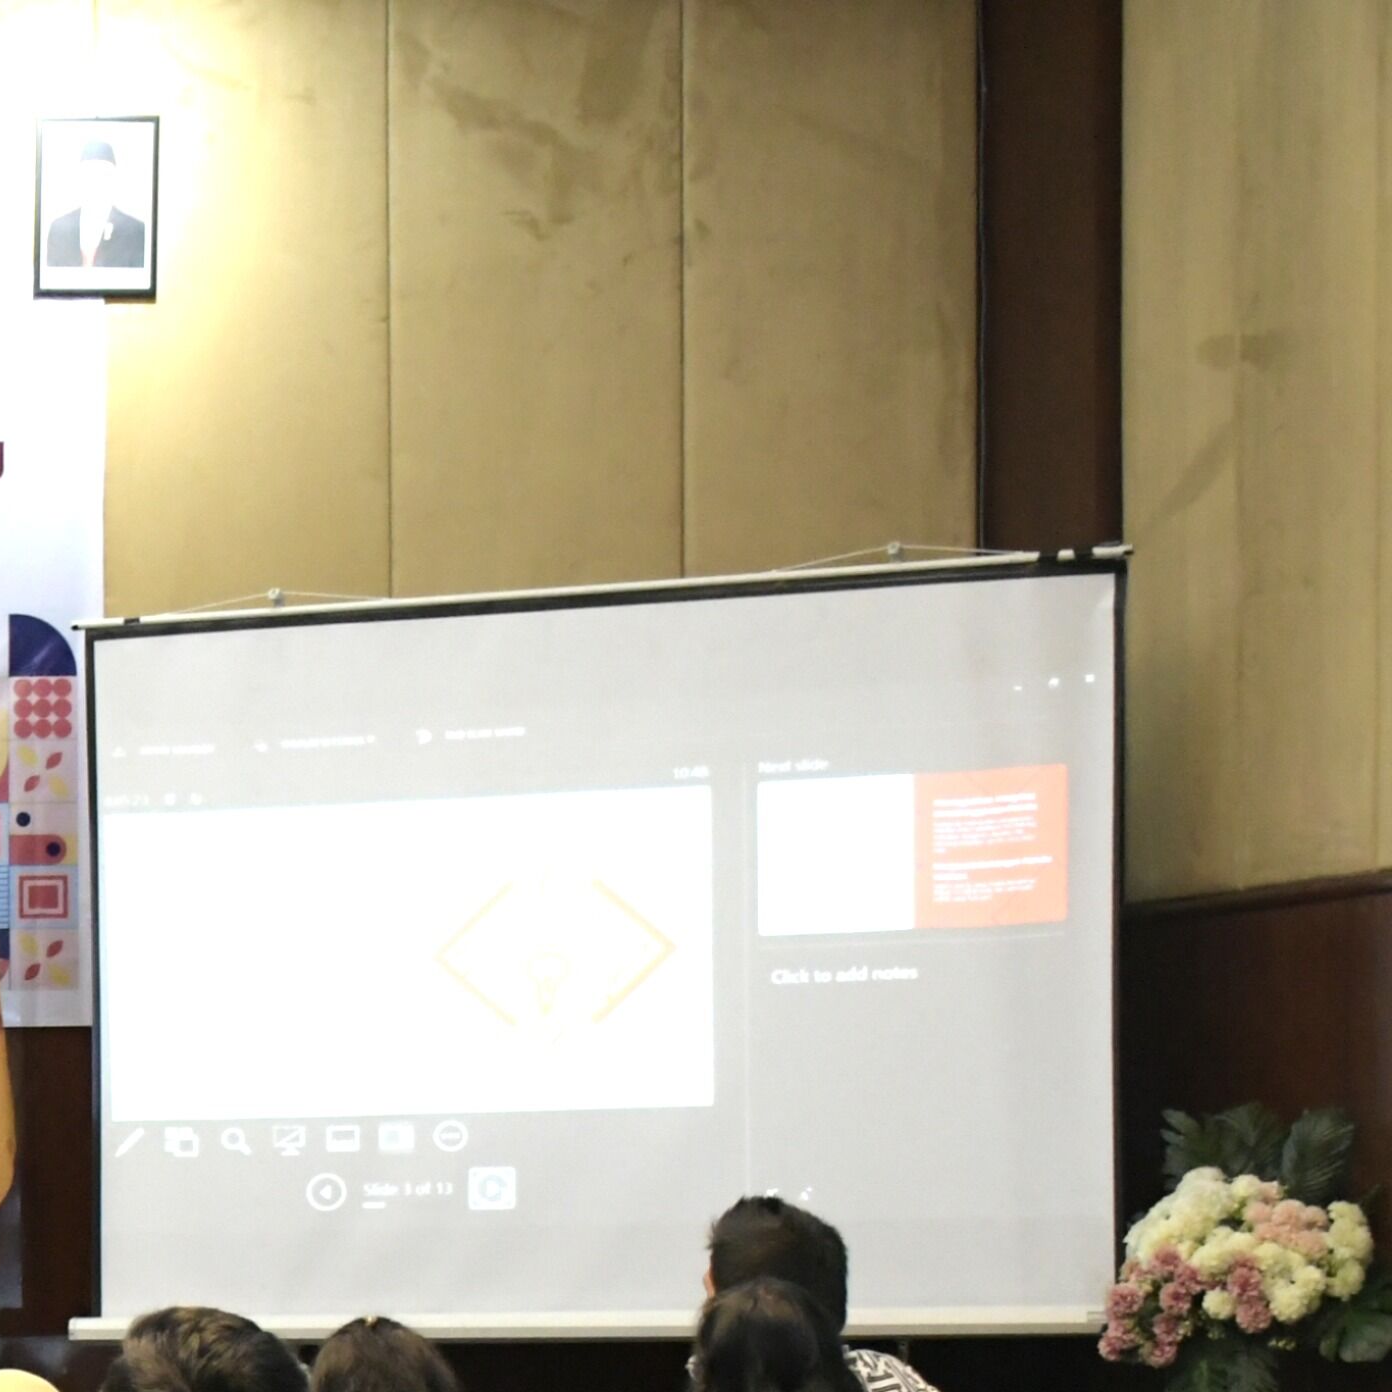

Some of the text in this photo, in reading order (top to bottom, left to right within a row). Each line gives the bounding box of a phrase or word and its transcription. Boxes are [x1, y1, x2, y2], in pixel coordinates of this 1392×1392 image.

[770, 964, 918, 984] Click to add notes
